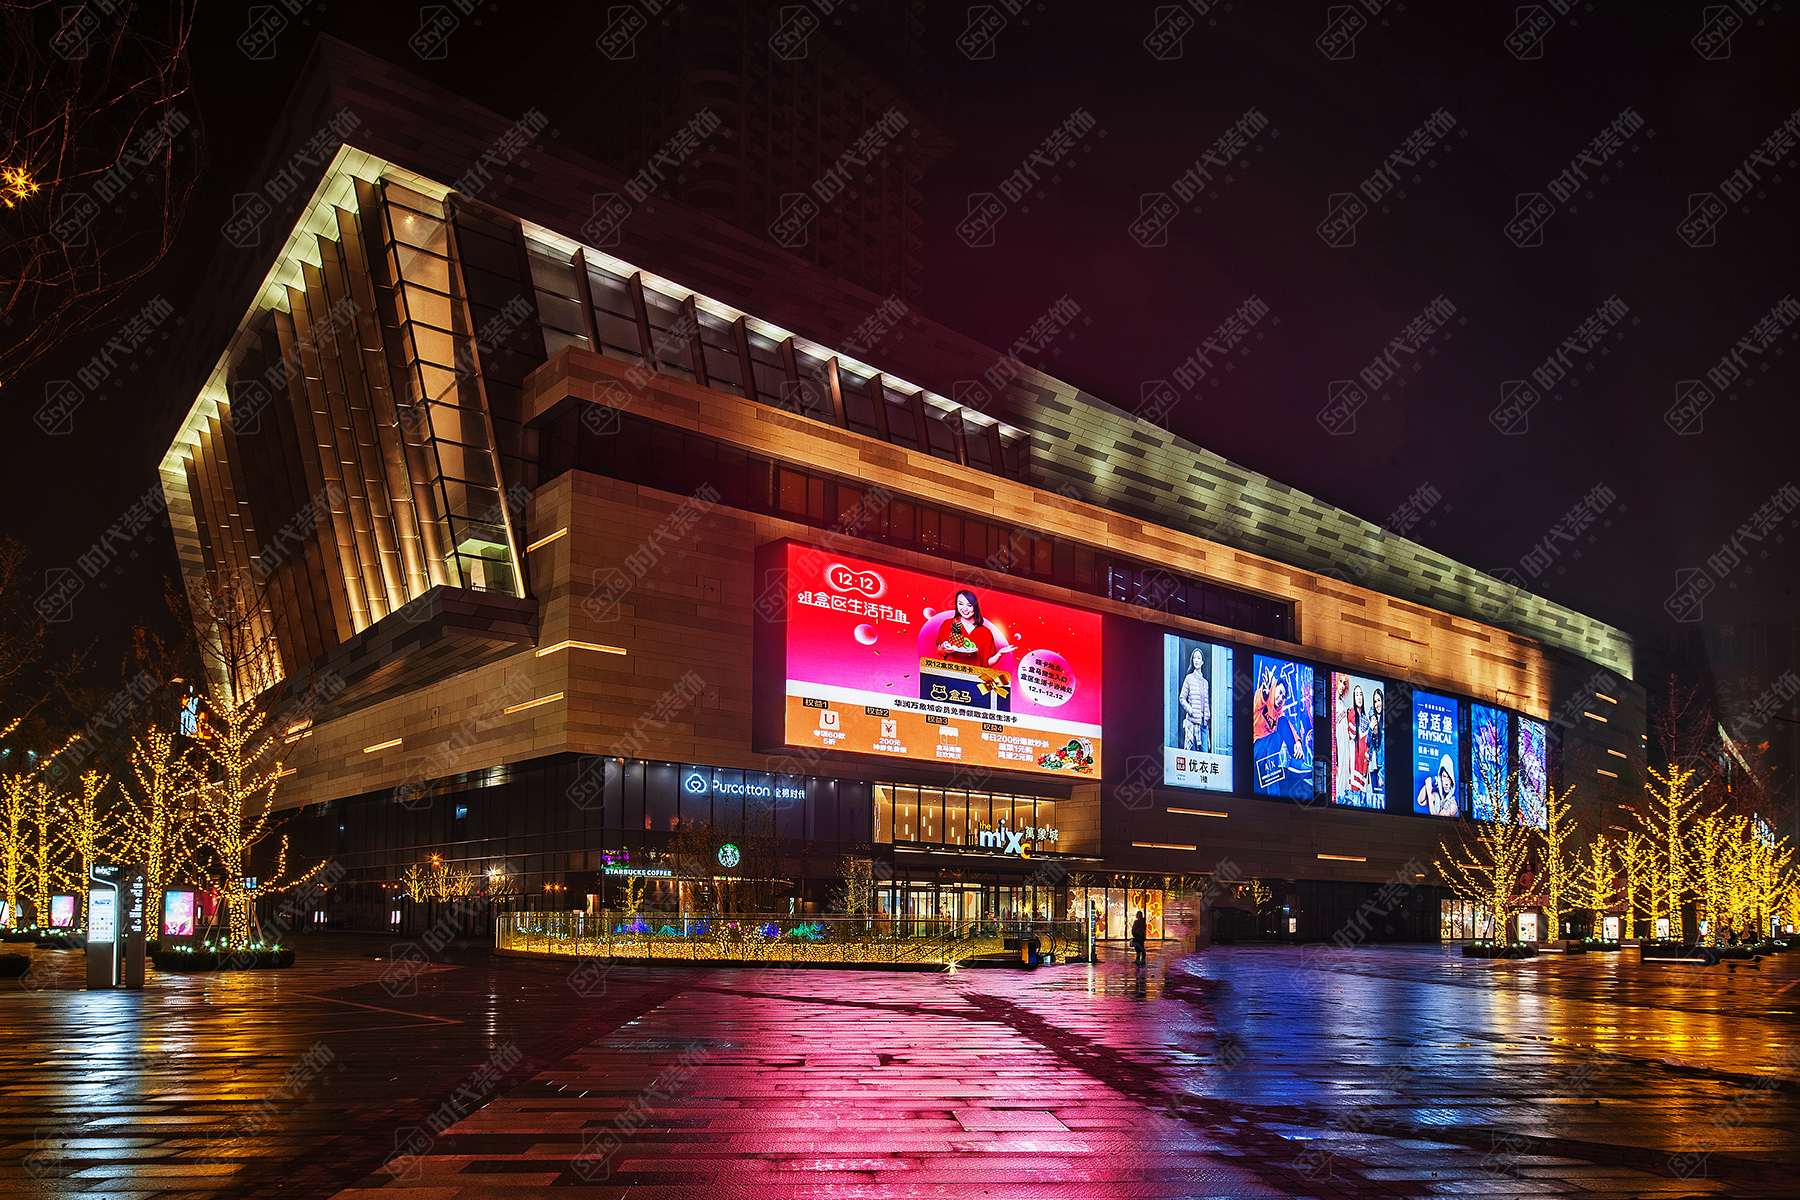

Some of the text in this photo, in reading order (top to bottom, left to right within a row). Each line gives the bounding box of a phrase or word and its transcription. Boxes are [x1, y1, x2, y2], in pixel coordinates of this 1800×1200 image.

[948, 689, 972, 703] 盒马
[1417, 710, 1453, 733] 舒适堡
[1417, 729, 1453, 744] PHYSICAL
[1189, 758, 1220, 775] 优衣库
[712, 779, 771, 797] Purcotton
[979, 820, 991, 831] the
[604, 868, 672, 877] STARBUCKS COFFEE
